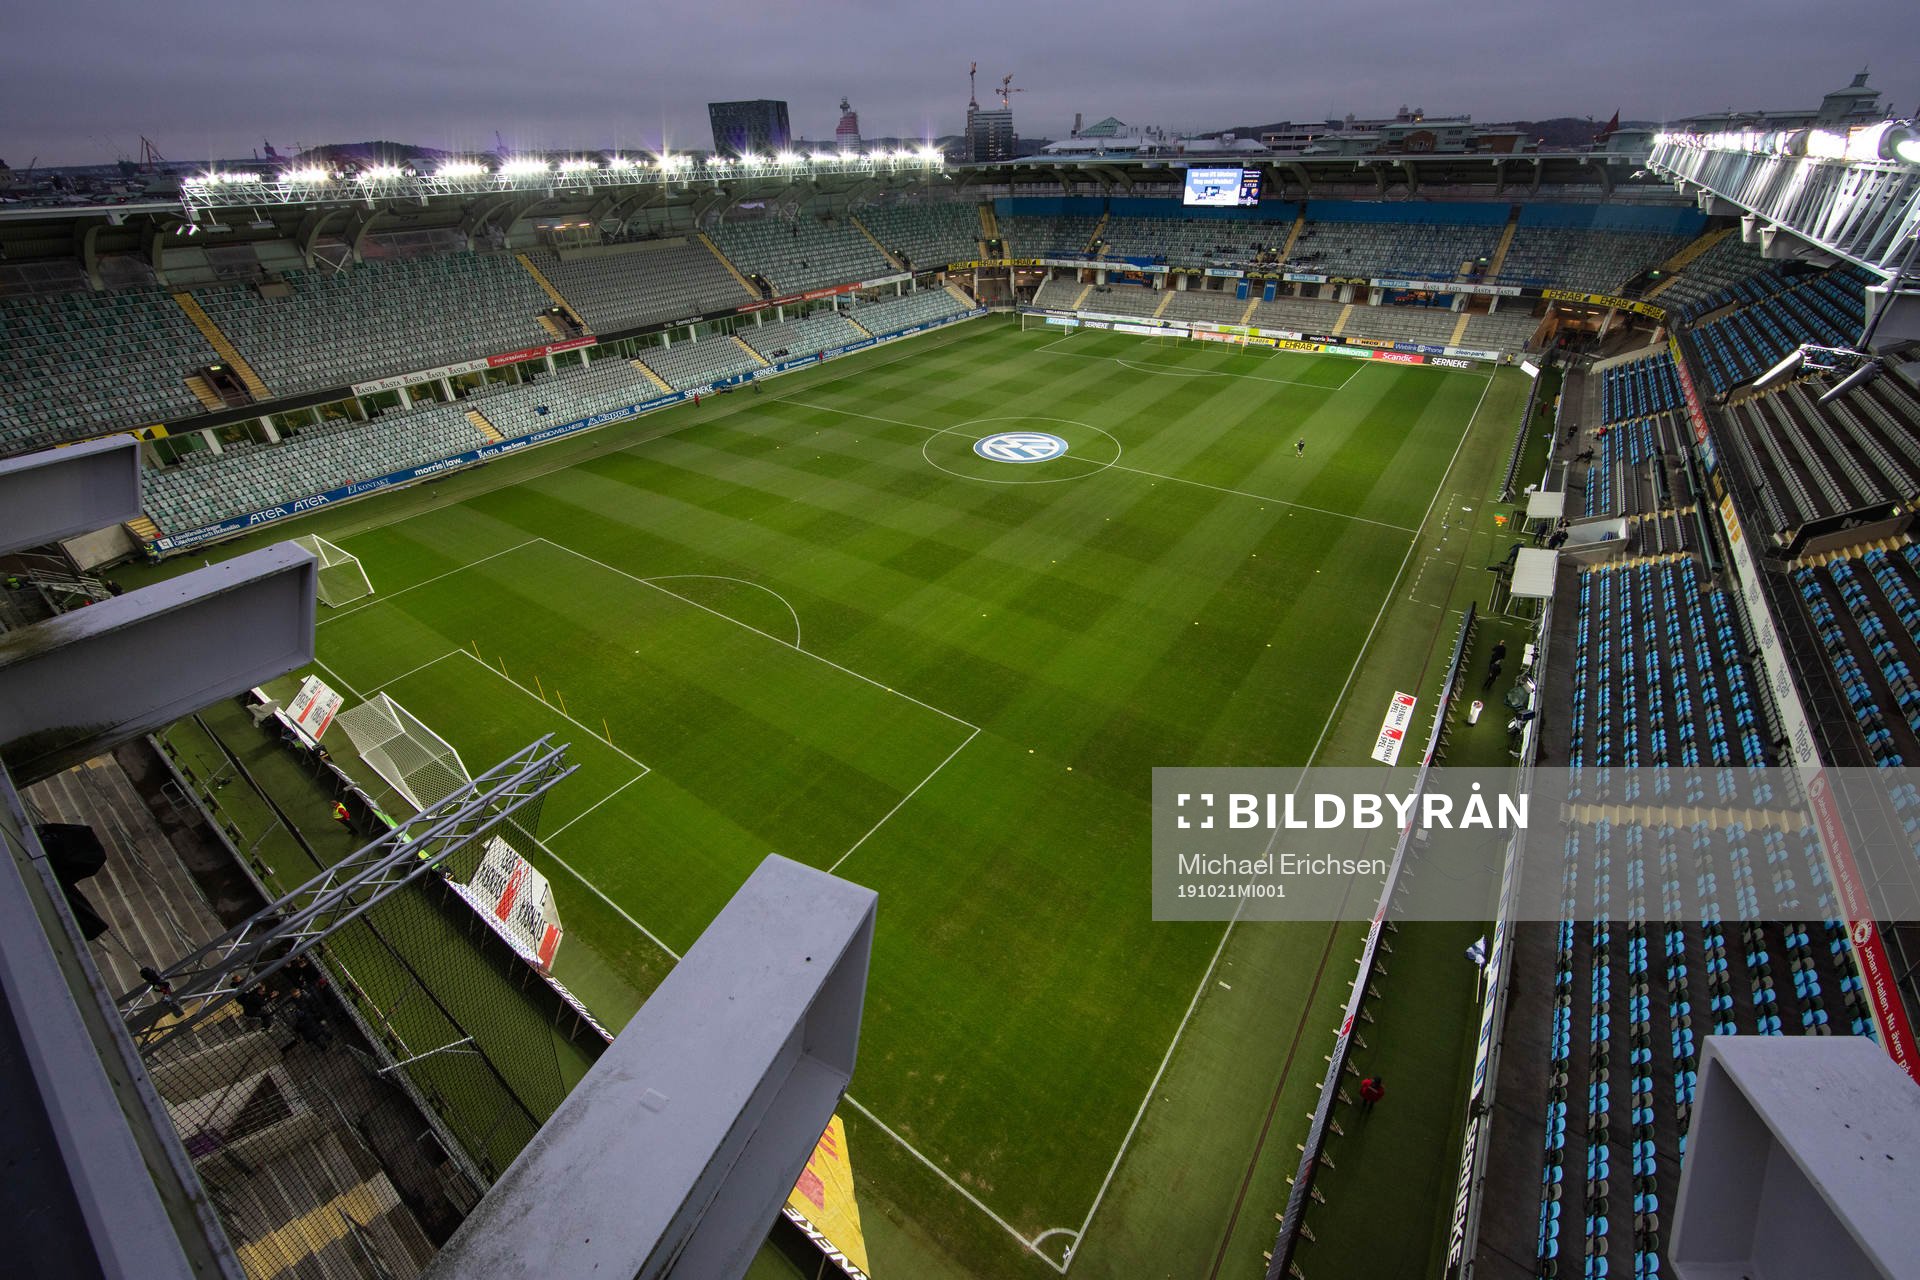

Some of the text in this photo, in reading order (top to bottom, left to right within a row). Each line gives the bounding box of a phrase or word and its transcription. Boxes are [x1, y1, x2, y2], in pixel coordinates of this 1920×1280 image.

[1549, 291, 1581, 301] EHRAB
[1600, 296, 1627, 309] EHRAB
[1284, 341, 1312, 351] EHRAB
[1382, 351, 1412, 363] Scandic
[1432, 357, 1468, 368] SERNEKE
[752, 366, 778, 378] SERNEKE
[380, 381, 401, 390] RASTA
[404, 376, 424, 385] RASTA
[355, 385, 377, 394] RASTA
[684, 384, 713, 399] SERNEKE
[599, 408, 630, 423] Kappa
[477, 448, 499, 460] RASTA
[294, 495, 330, 512] ATEA
[250, 507, 288, 525] ATEA
[1390, 702, 1400, 713] SPEL
[1395, 704, 1408, 726] SVENSKA
[1377, 736, 1388, 749] SPEL
[1383, 739, 1396, 762] SVENSKA
[1864, 946, 1878, 975] Johan
[1876, 978, 1890, 1015] Hallen.
[1886, 1012, 1895, 1031] Nu
[1891, 1031, 1905, 1058] även
[1448, 1117, 1478, 1269] SERNEKE
